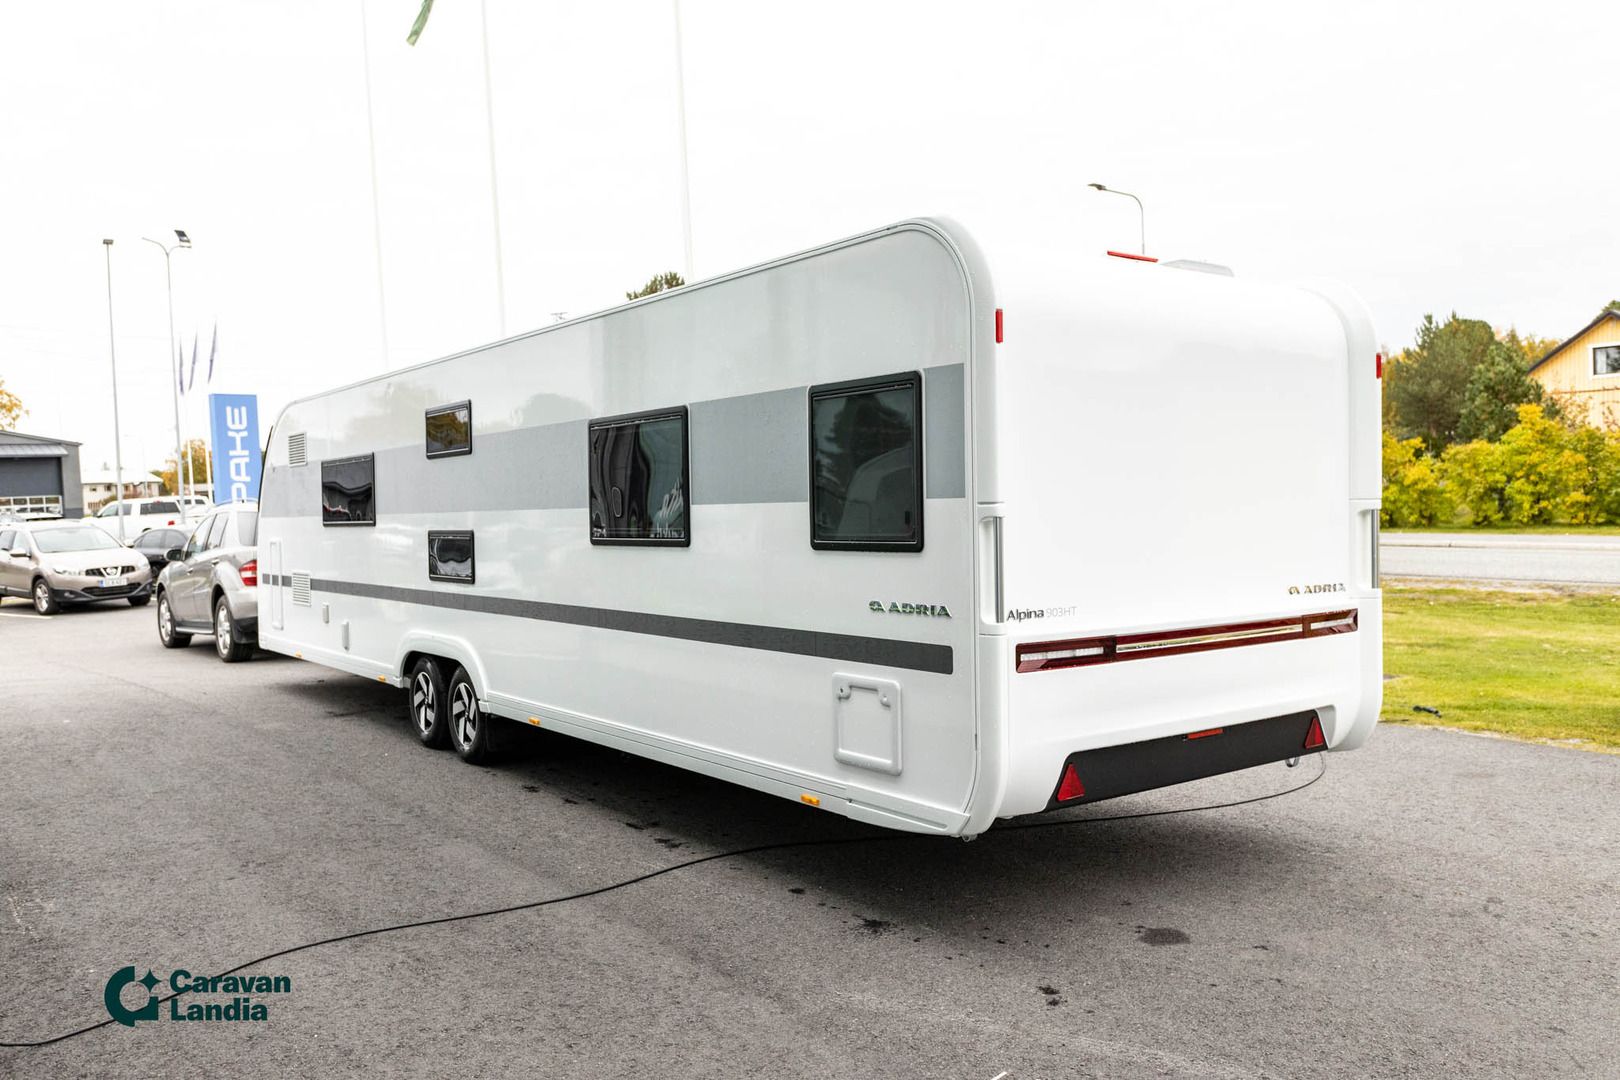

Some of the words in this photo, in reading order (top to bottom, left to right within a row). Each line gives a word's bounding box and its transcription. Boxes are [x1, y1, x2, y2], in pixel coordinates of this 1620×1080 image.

[1304, 583, 1346, 594] ADRIA
[888, 601, 952, 618] ADRIA
[1006, 609, 1045, 623] Alpina
[1046, 602, 1077, 617] 903HT
